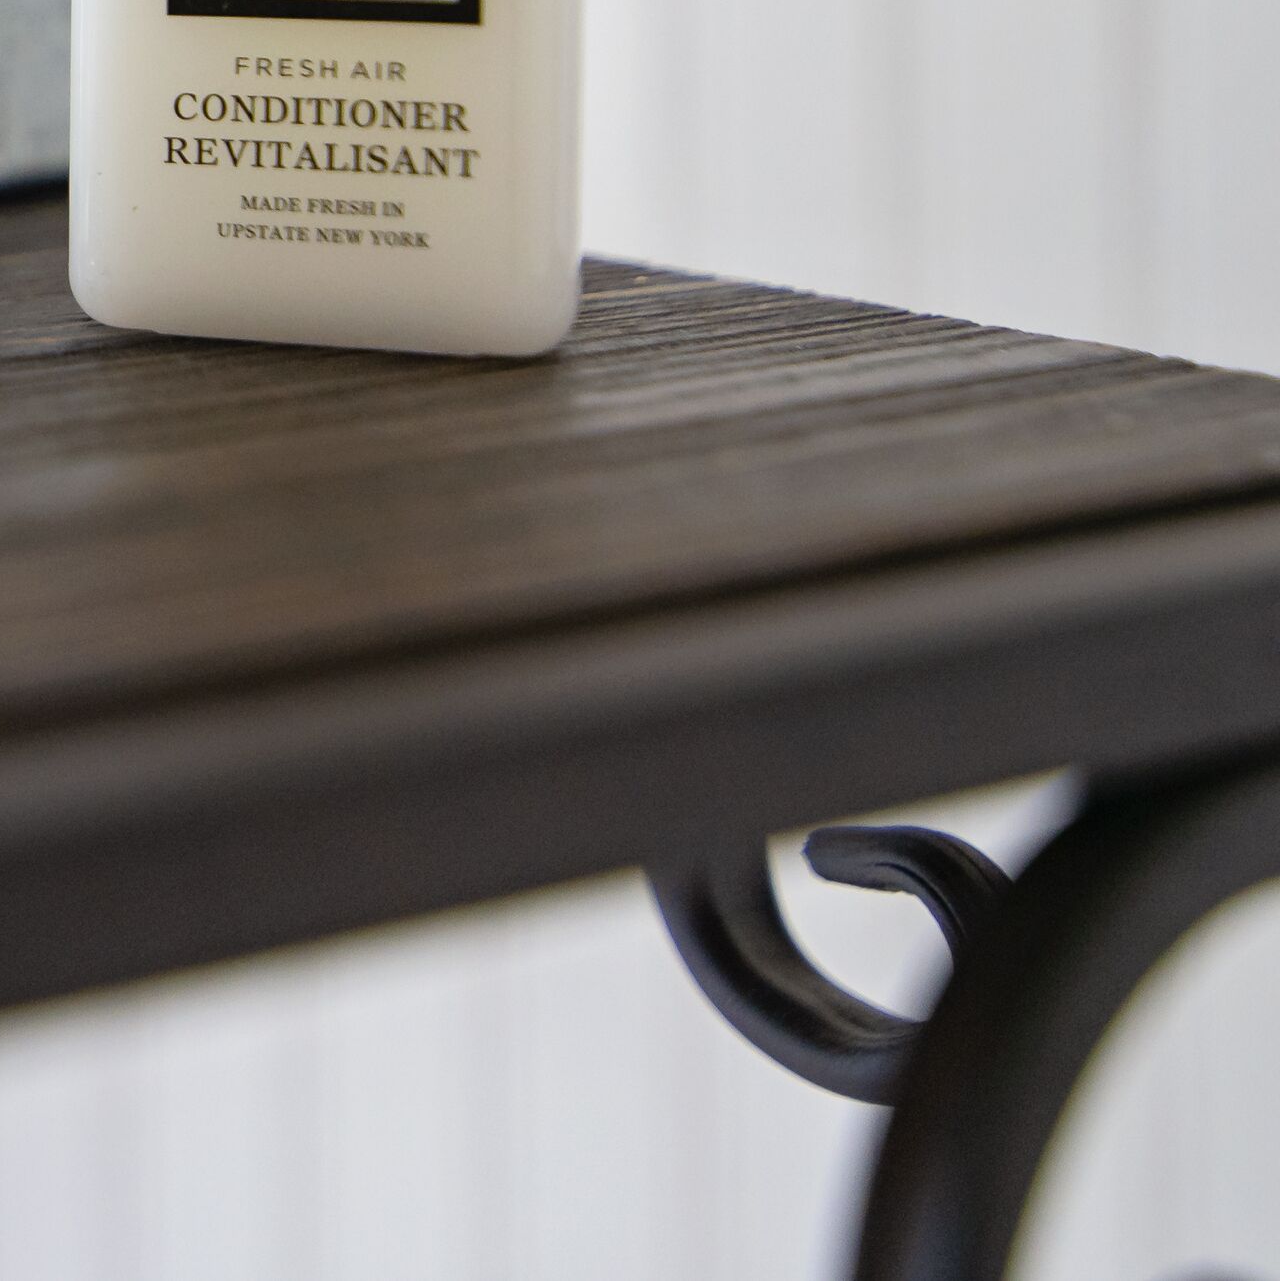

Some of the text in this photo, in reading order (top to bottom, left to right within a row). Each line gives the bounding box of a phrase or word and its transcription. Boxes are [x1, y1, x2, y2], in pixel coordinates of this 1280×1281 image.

[235, 56, 407, 82] FRESH AIR
[173, 92, 469, 132] CONDITIONER
[163, 136, 479, 179] REVITALISANT
[240, 194, 405, 218] MADE FRESH IN
[216, 222, 430, 249] UPSTATE NEW YORK
